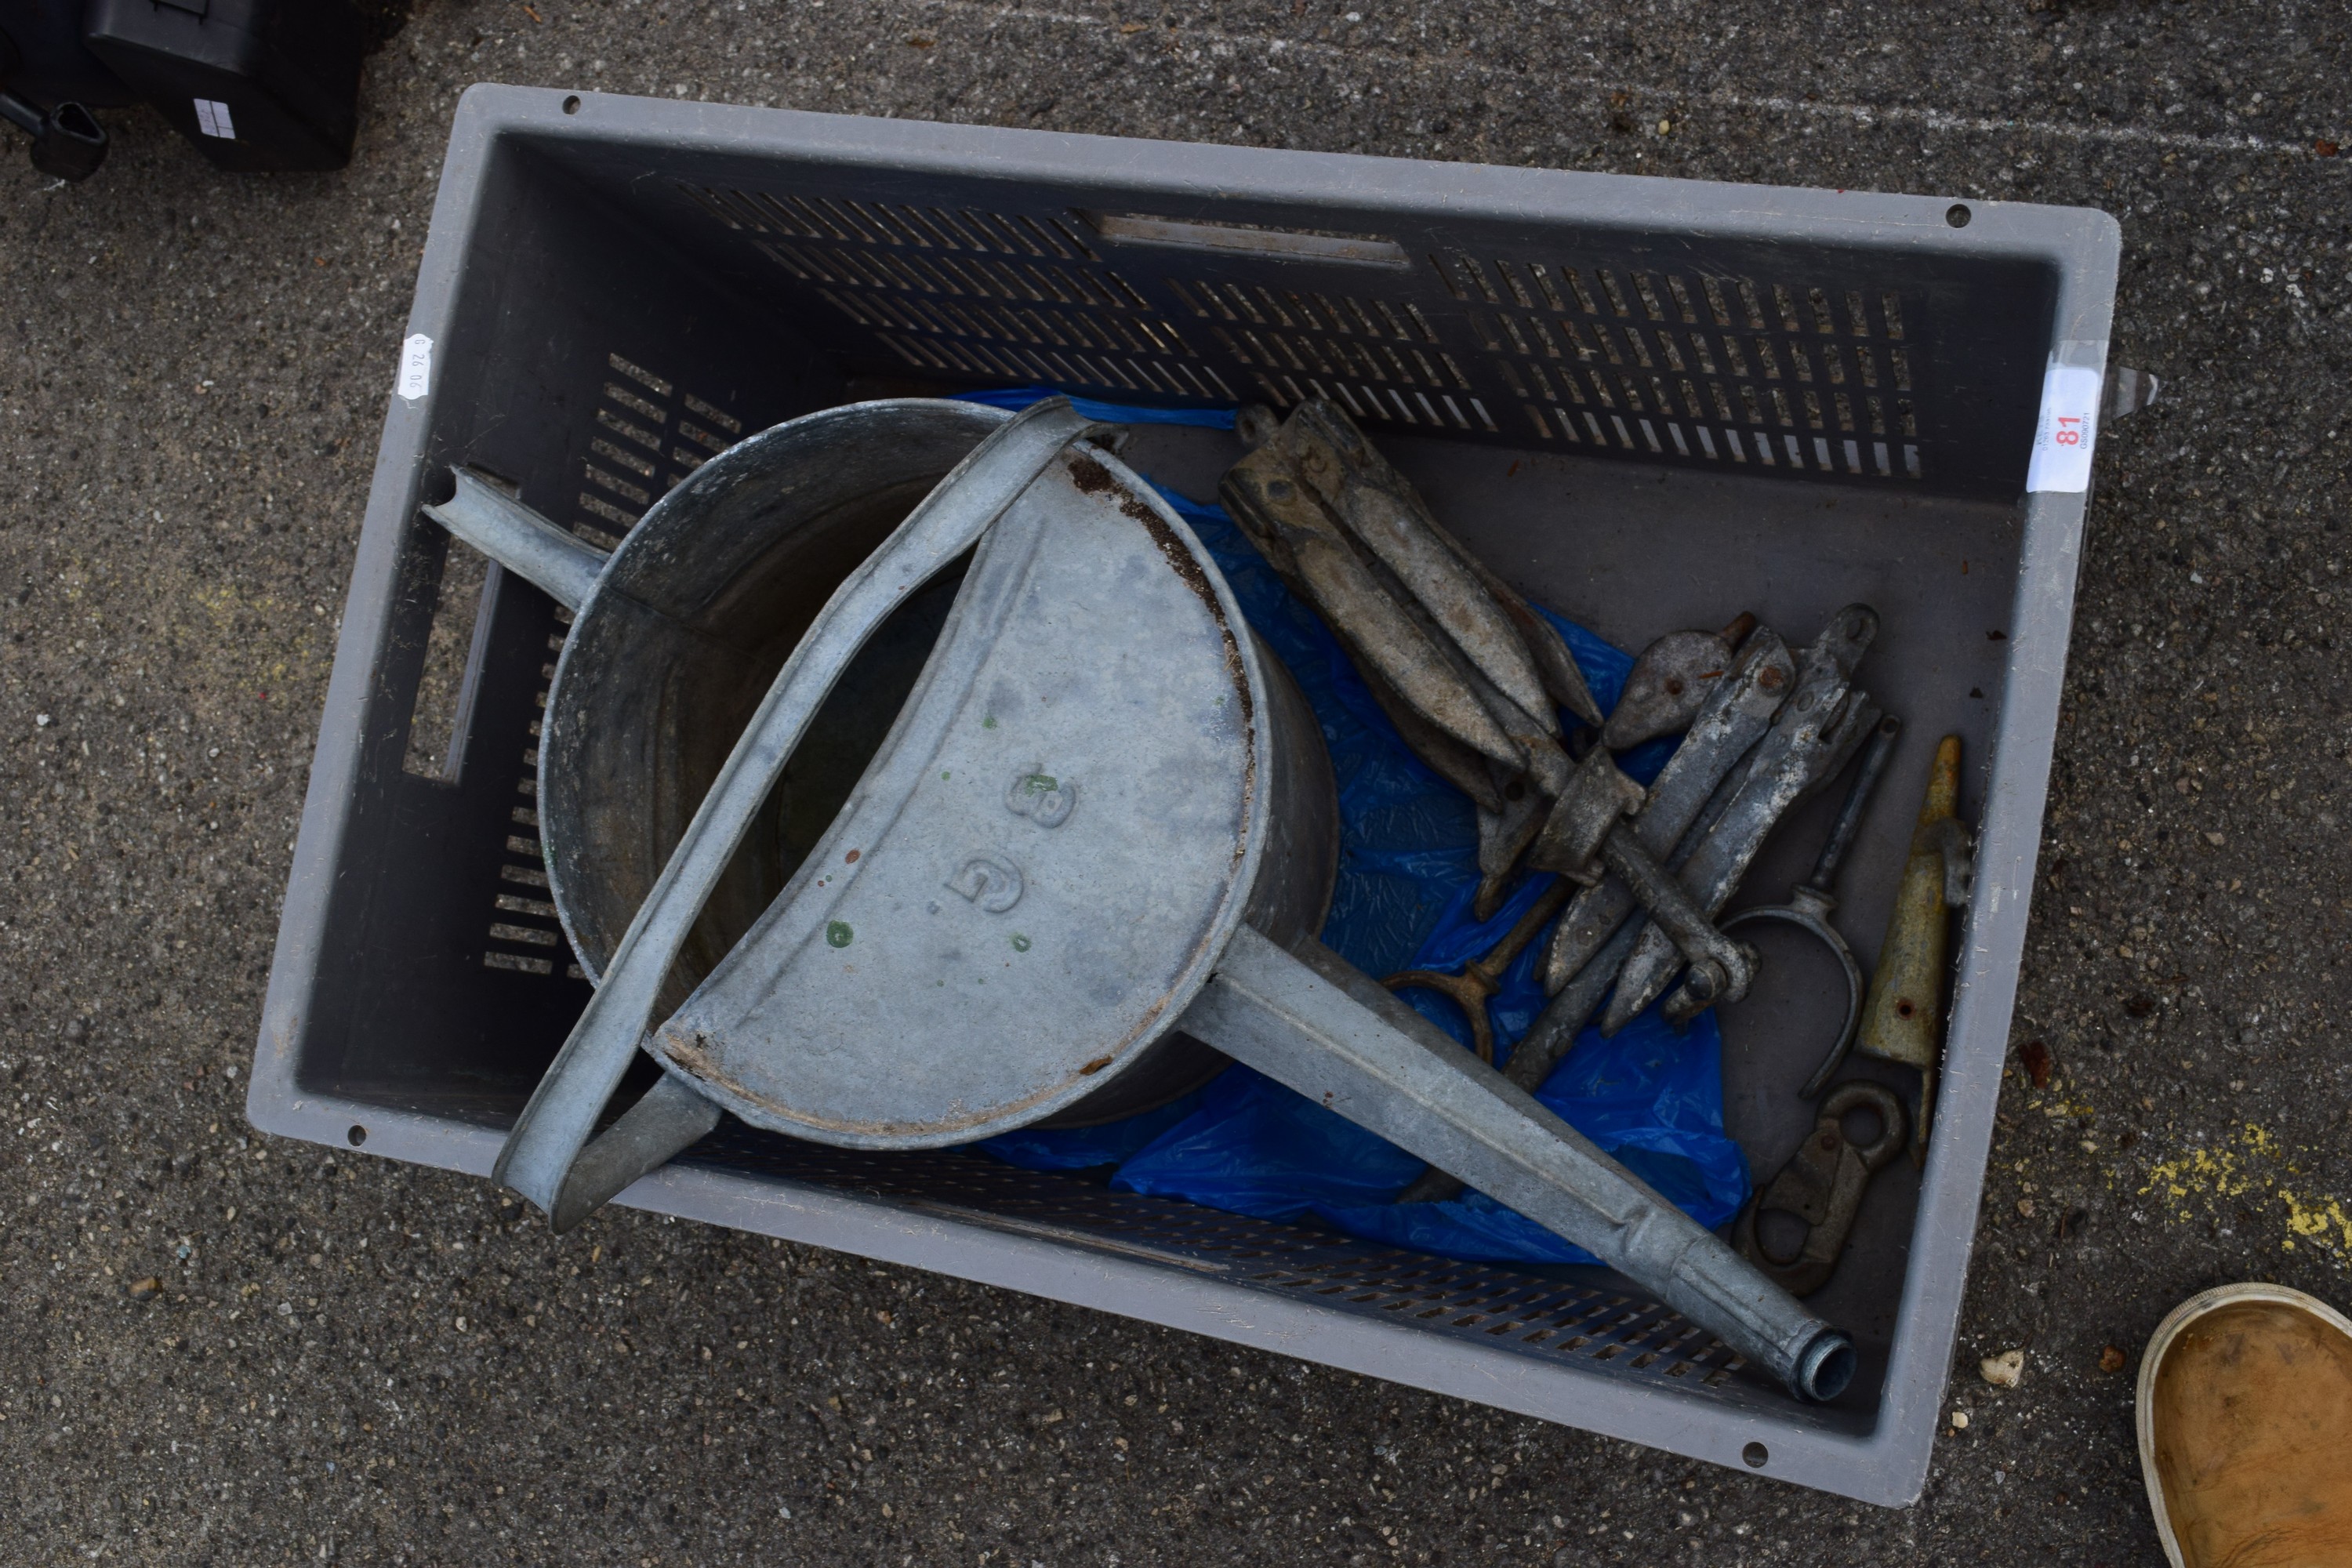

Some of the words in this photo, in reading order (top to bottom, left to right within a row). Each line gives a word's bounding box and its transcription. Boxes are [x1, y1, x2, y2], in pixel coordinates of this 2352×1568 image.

[412, 354, 425, 366] 26
[409, 375, 422, 387] 06
[2056, 416, 2082, 445] 81
[2080, 412, 2090, 449] GS090721
